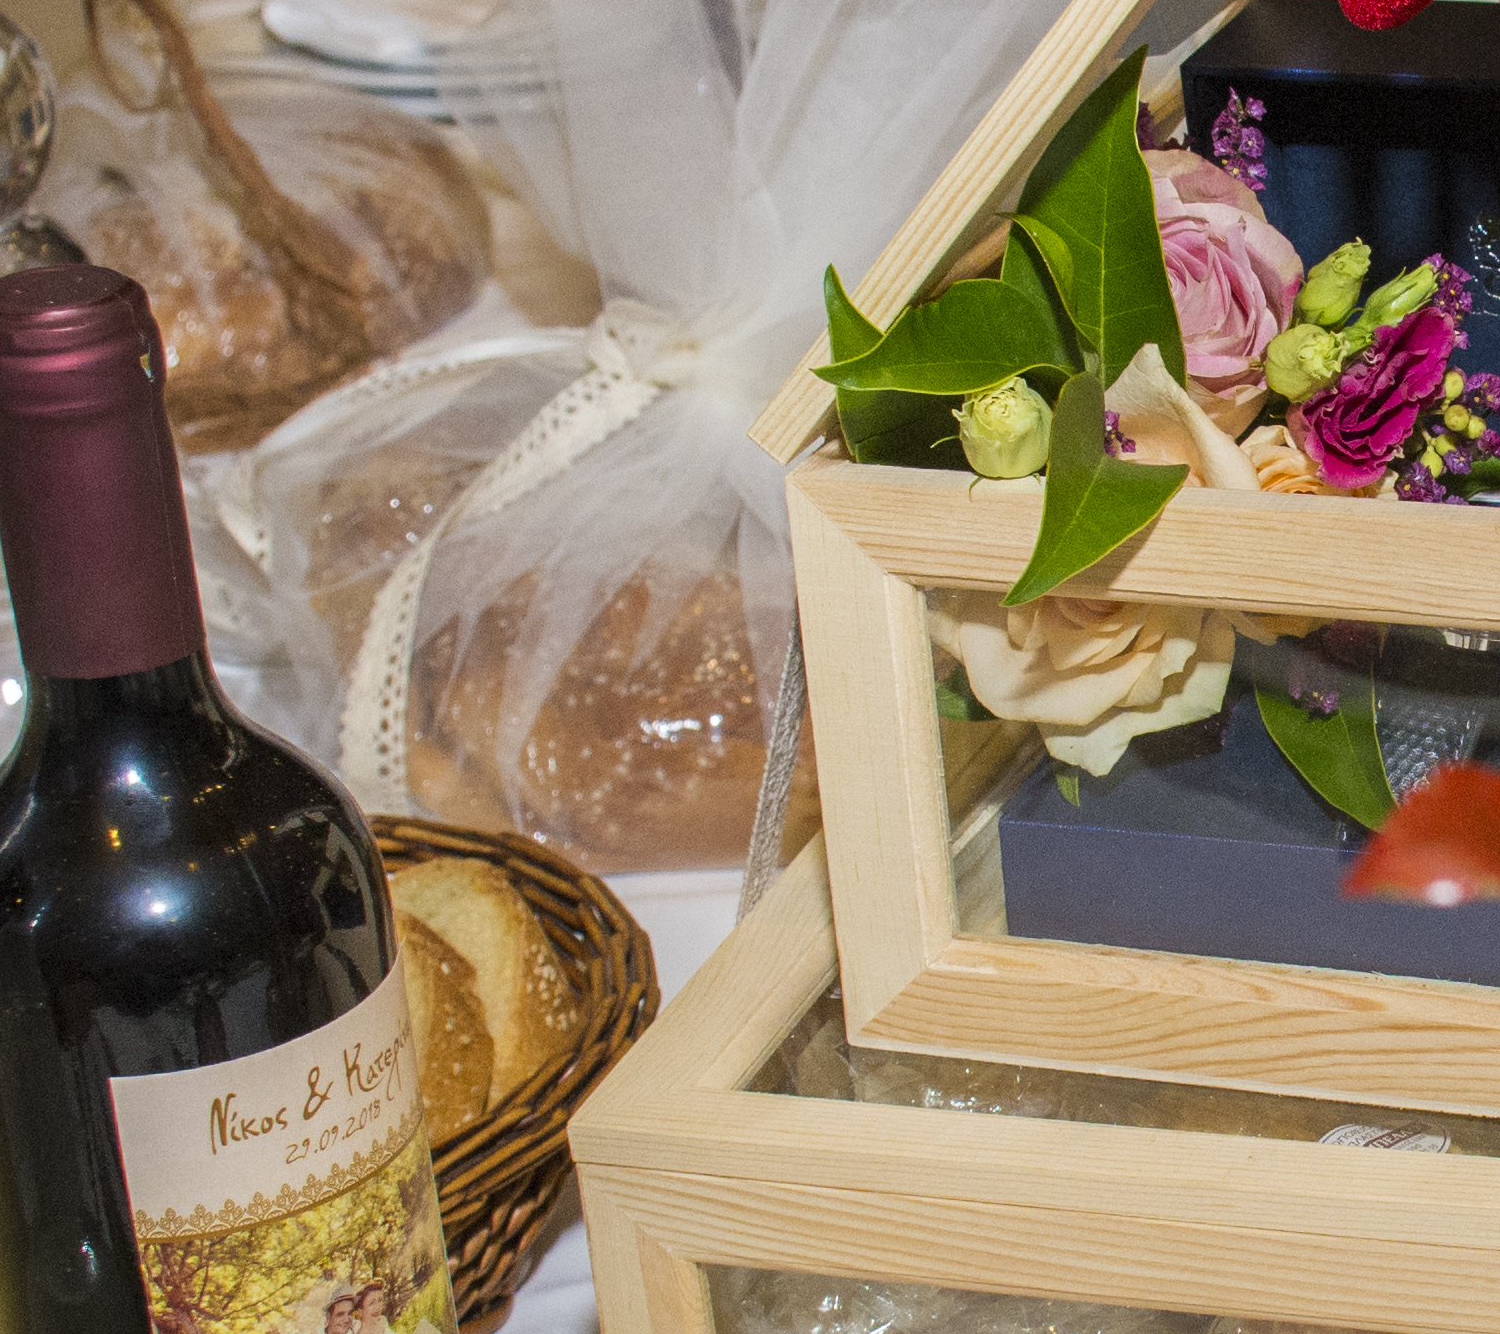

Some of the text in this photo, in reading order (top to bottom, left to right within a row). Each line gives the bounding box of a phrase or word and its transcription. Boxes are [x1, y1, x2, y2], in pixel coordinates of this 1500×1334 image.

[210, 1092, 289, 1156] Νίκος
[302, 1065, 335, 1121] &
[285, 1098, 382, 1165] 29.09.2018
